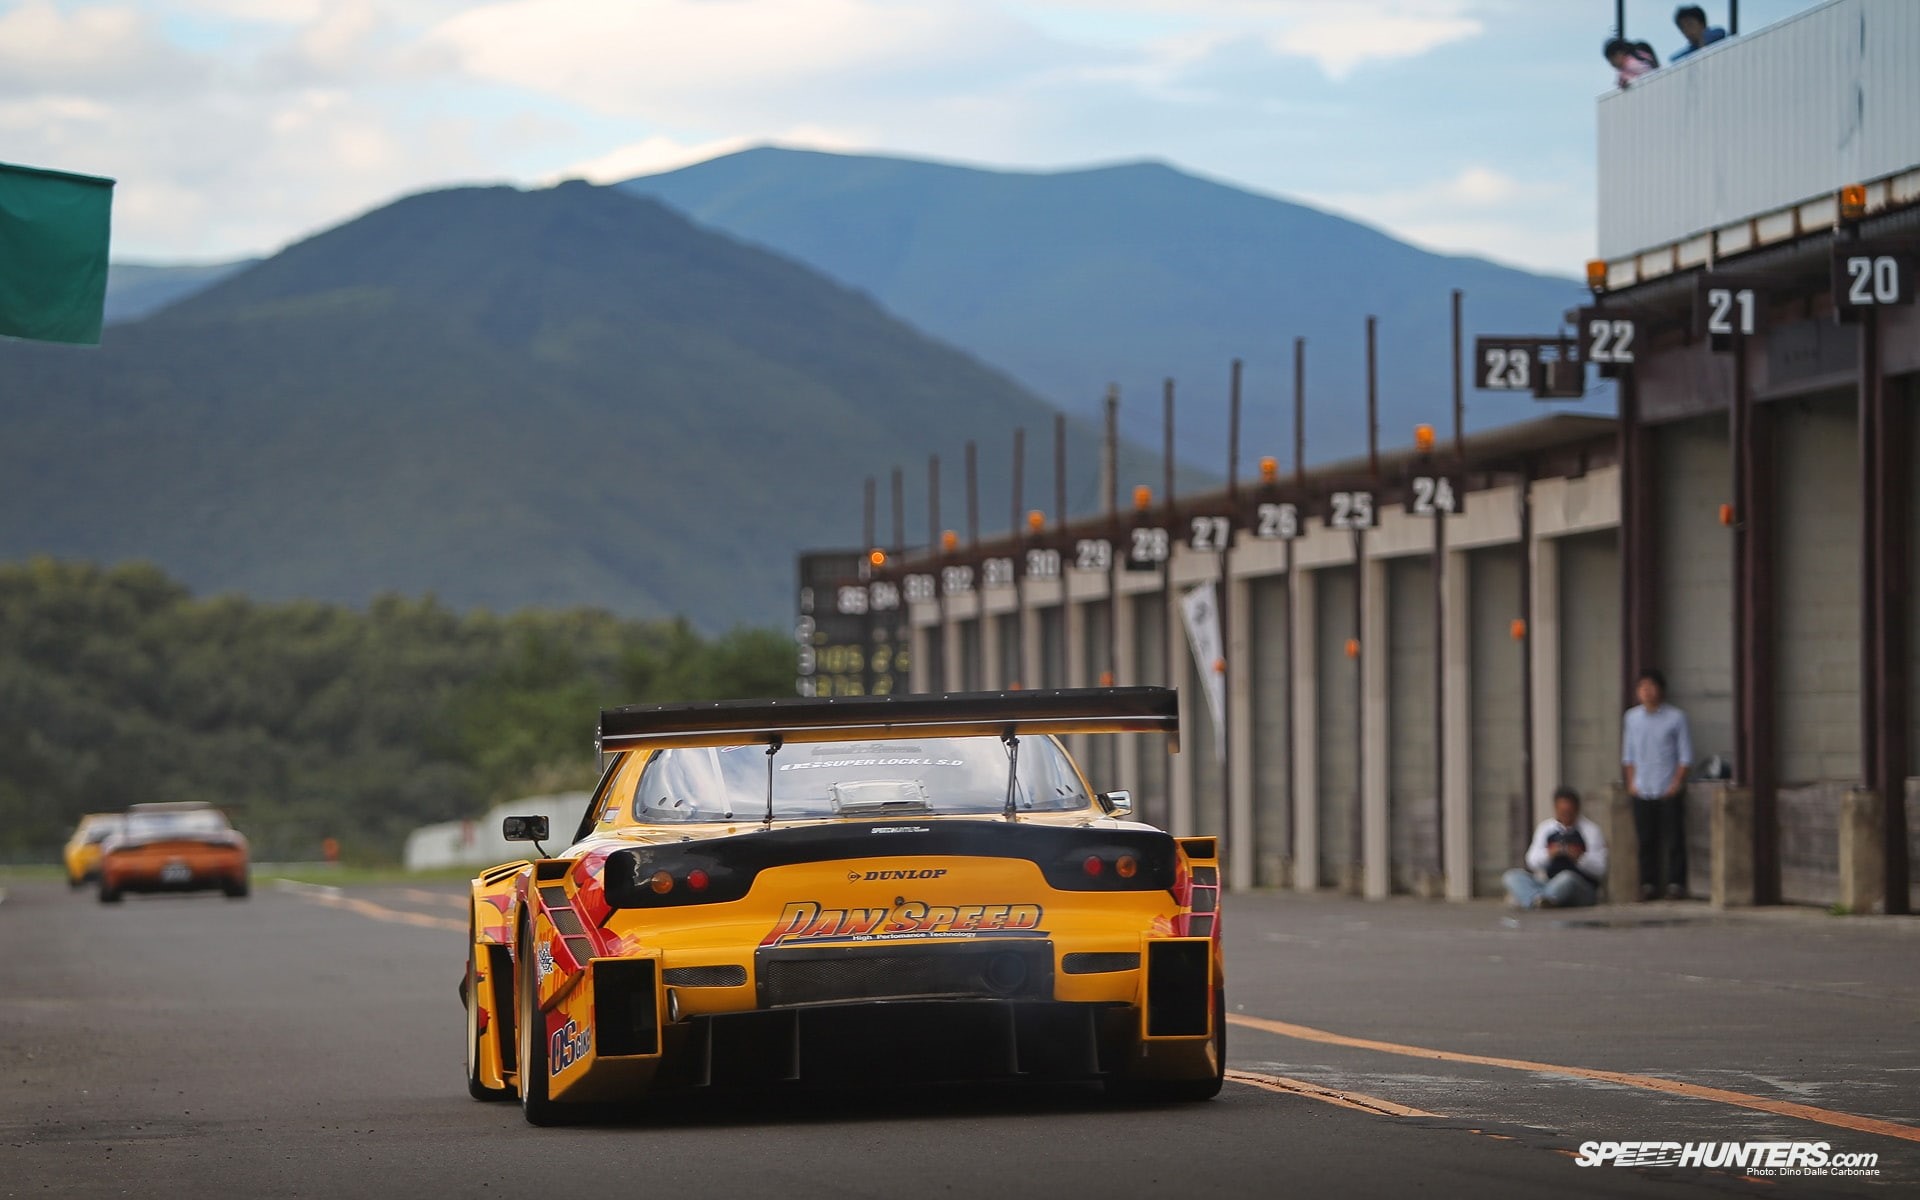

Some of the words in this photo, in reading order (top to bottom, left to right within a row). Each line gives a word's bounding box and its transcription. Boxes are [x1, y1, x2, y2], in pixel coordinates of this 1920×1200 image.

[1848, 257, 1899, 304] 20
[1708, 289, 1754, 334] 21
[1590, 320, 1635, 363] 22
[1486, 349, 1530, 388] 23
[1330, 492, 1373, 529] 25
[1413, 477, 1455, 514] 24
[1191, 517, 1230, 551] 27
[1257, 503, 1297, 539] 26
[1076, 539, 1112, 571] 29
[1131, 528, 1168, 561] 28
[942, 566, 974, 595] 32
[983, 558, 1014, 587] 31
[1026, 549, 1060, 577] 30
[822, 759, 876, 768] SUPER
[863, 869, 947, 881] DUNLOP
[759, 901, 888, 948] PAN
[885, 899, 1044, 933] SPEED
[551, 1019, 577, 1078] OS
